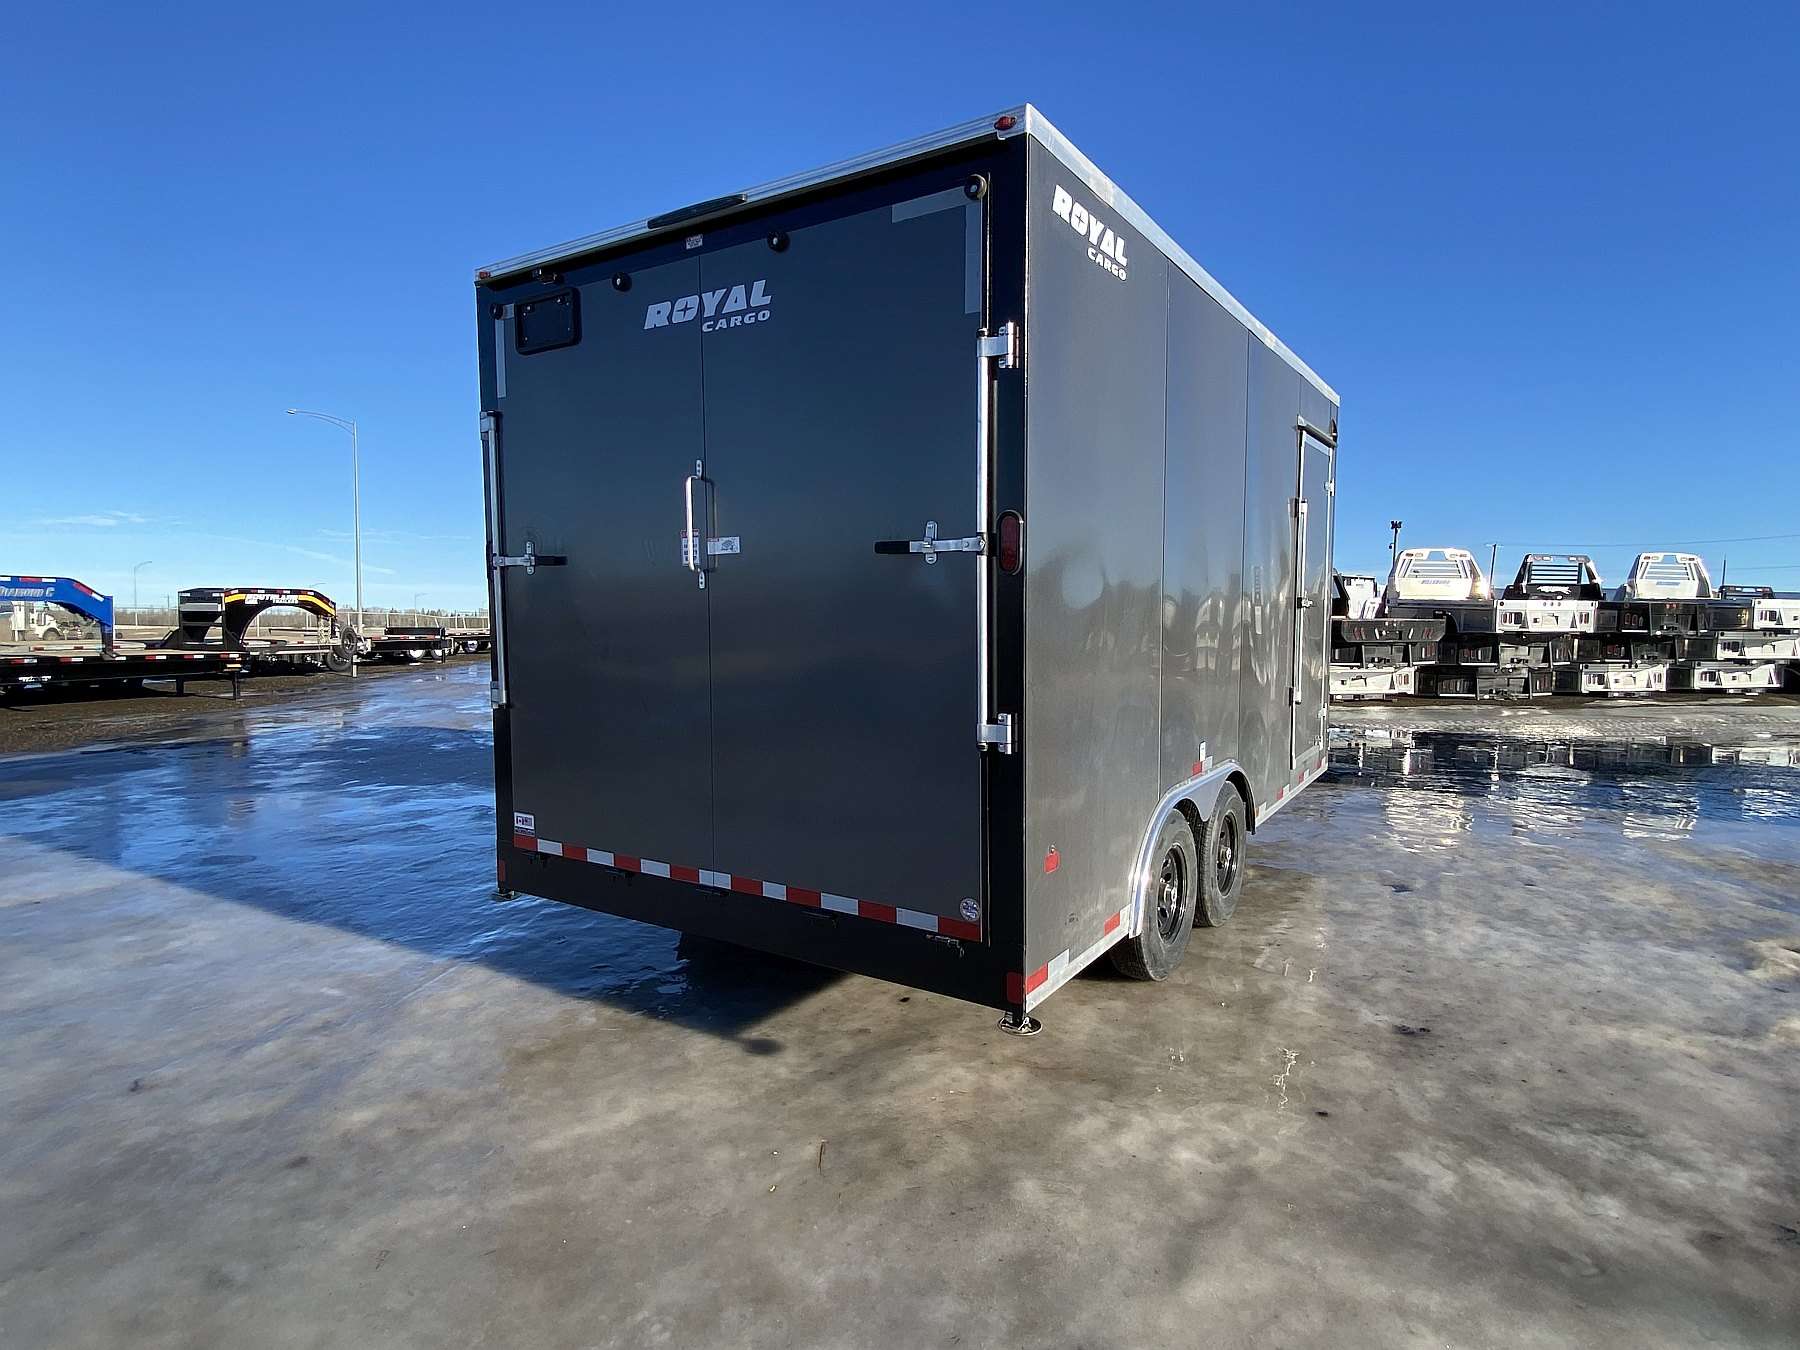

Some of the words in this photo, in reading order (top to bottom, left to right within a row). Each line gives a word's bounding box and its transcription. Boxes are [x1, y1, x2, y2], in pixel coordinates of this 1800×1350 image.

[1052, 184, 1128, 267] ROYAL
[1087, 247, 1127, 281] CARGO
[643, 280, 772, 330] ROYAL
[702, 310, 771, 333] CARGO
